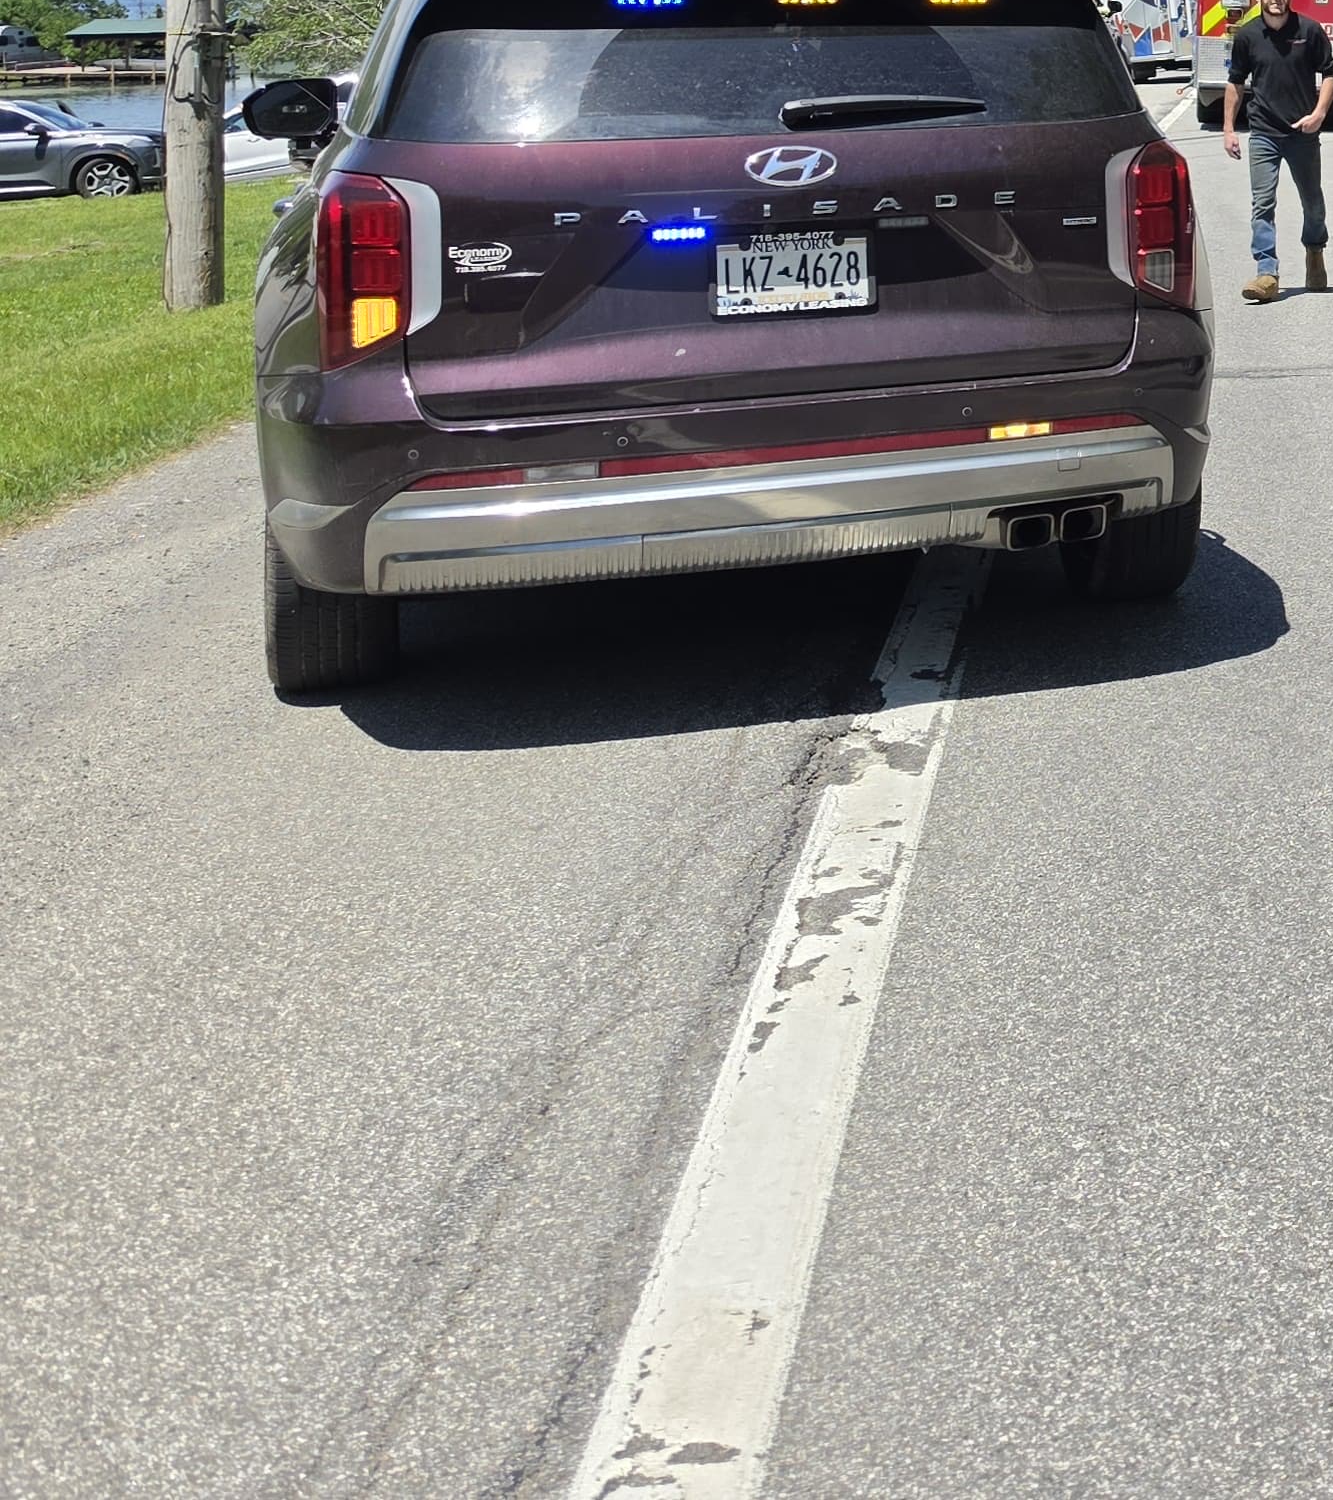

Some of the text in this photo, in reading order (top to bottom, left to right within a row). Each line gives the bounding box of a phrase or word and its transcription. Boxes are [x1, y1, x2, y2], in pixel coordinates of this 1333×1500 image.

[553, 190, 1015, 226] PALISADE
[750, 231, 834, 243] 718-395-4077
[752, 237, 833, 253] NEW YORK
[448, 246, 506, 259] Economy
[716, 298, 868, 316] ECONOMY LEASING
